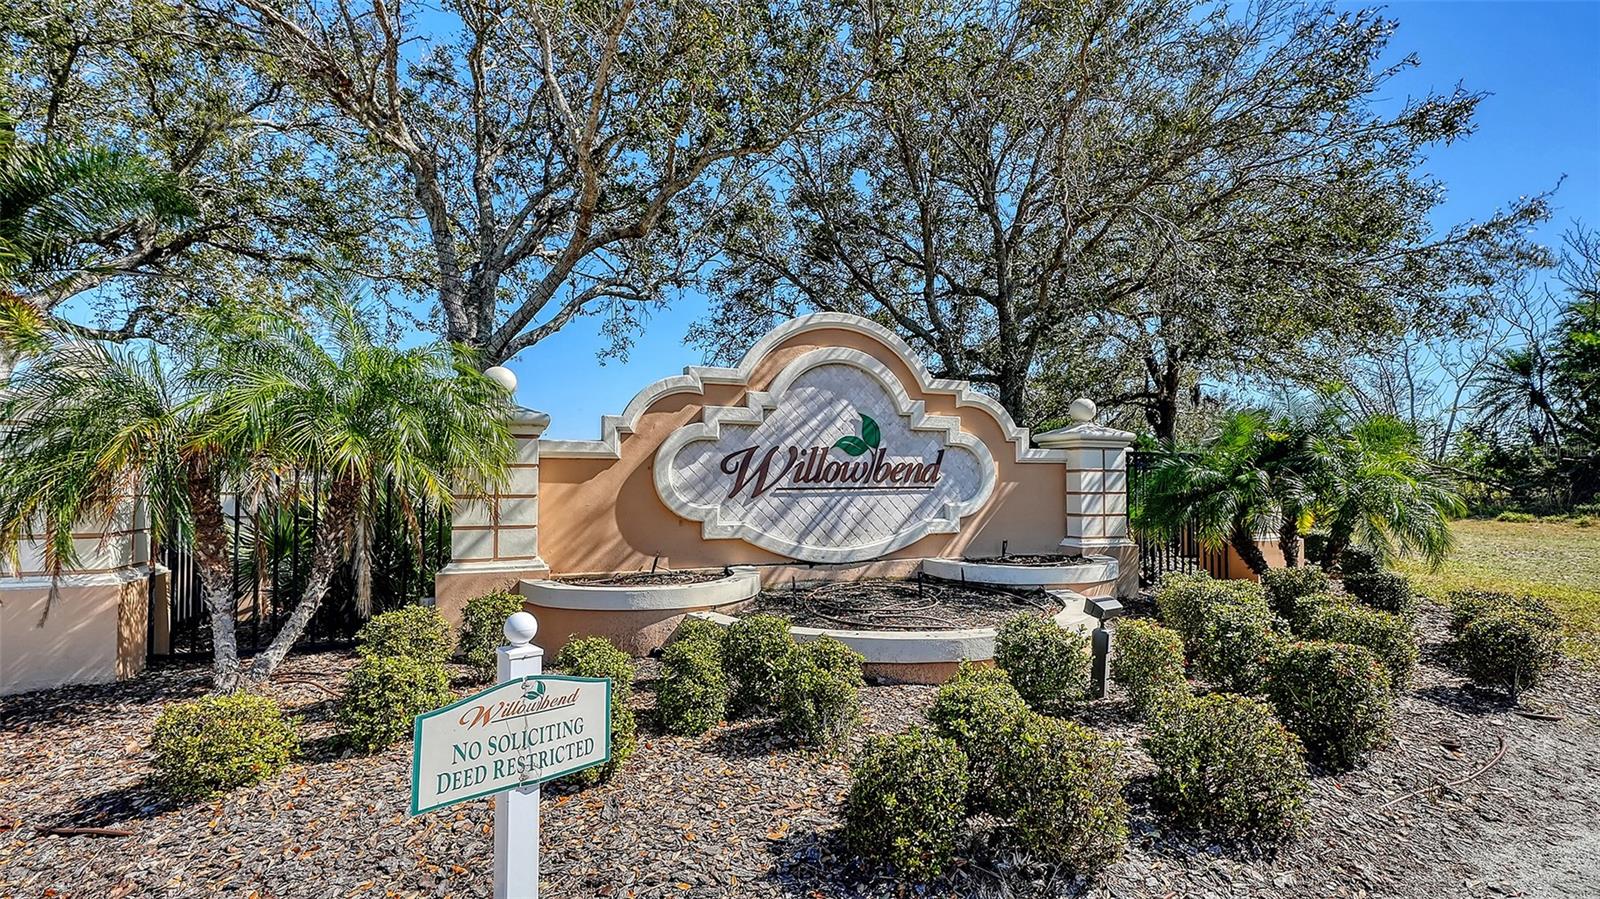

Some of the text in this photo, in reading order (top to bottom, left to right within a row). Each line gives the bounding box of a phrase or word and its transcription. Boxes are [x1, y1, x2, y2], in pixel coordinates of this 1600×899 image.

[720, 445, 945, 499] Willowbend
[459, 688, 581, 730] Willowbend
[436, 737, 594, 795] DEED RESTRICTED
[451, 717, 584, 765] NO SOLICITING
